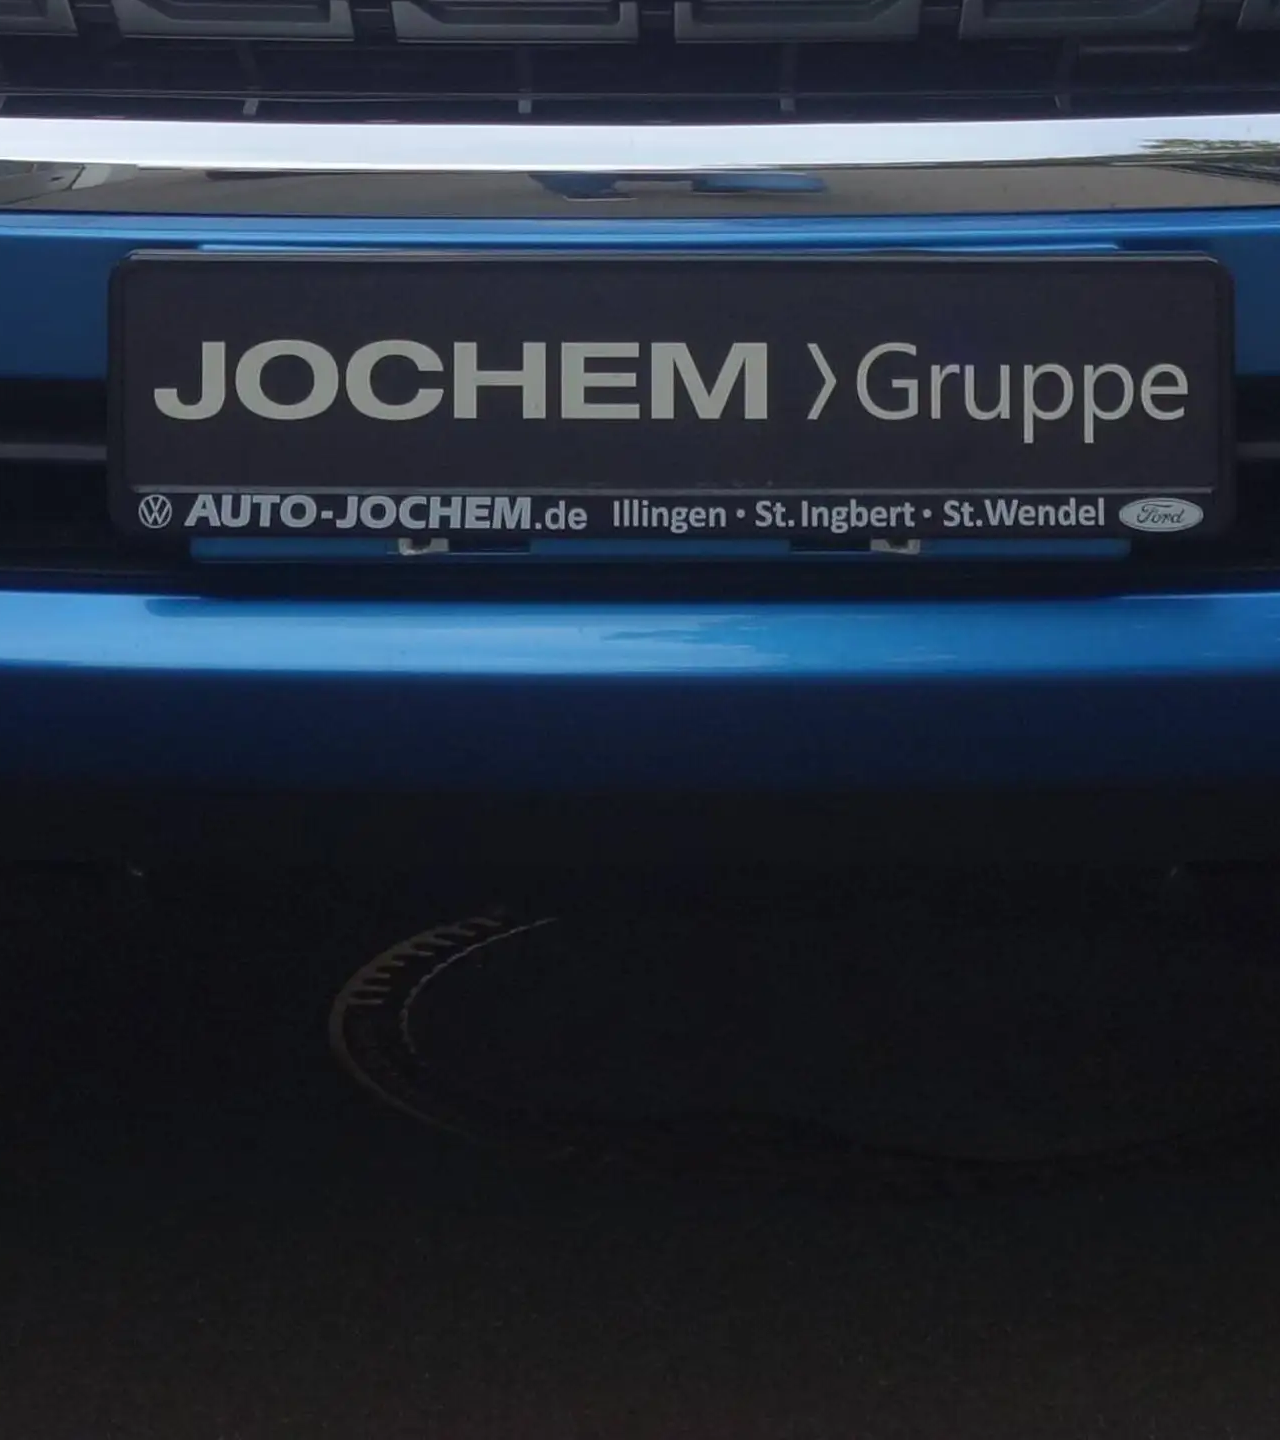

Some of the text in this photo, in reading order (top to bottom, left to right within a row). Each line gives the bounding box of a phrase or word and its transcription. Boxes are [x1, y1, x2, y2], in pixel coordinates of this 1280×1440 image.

[153, 339, 1189, 444] JOCHEM Gruppe
[184, 495, 588, 530] AUTO-JOCHEM.de
[613, 499, 727, 534] Illingen
[1136, 503, 1185, 524] Ford
